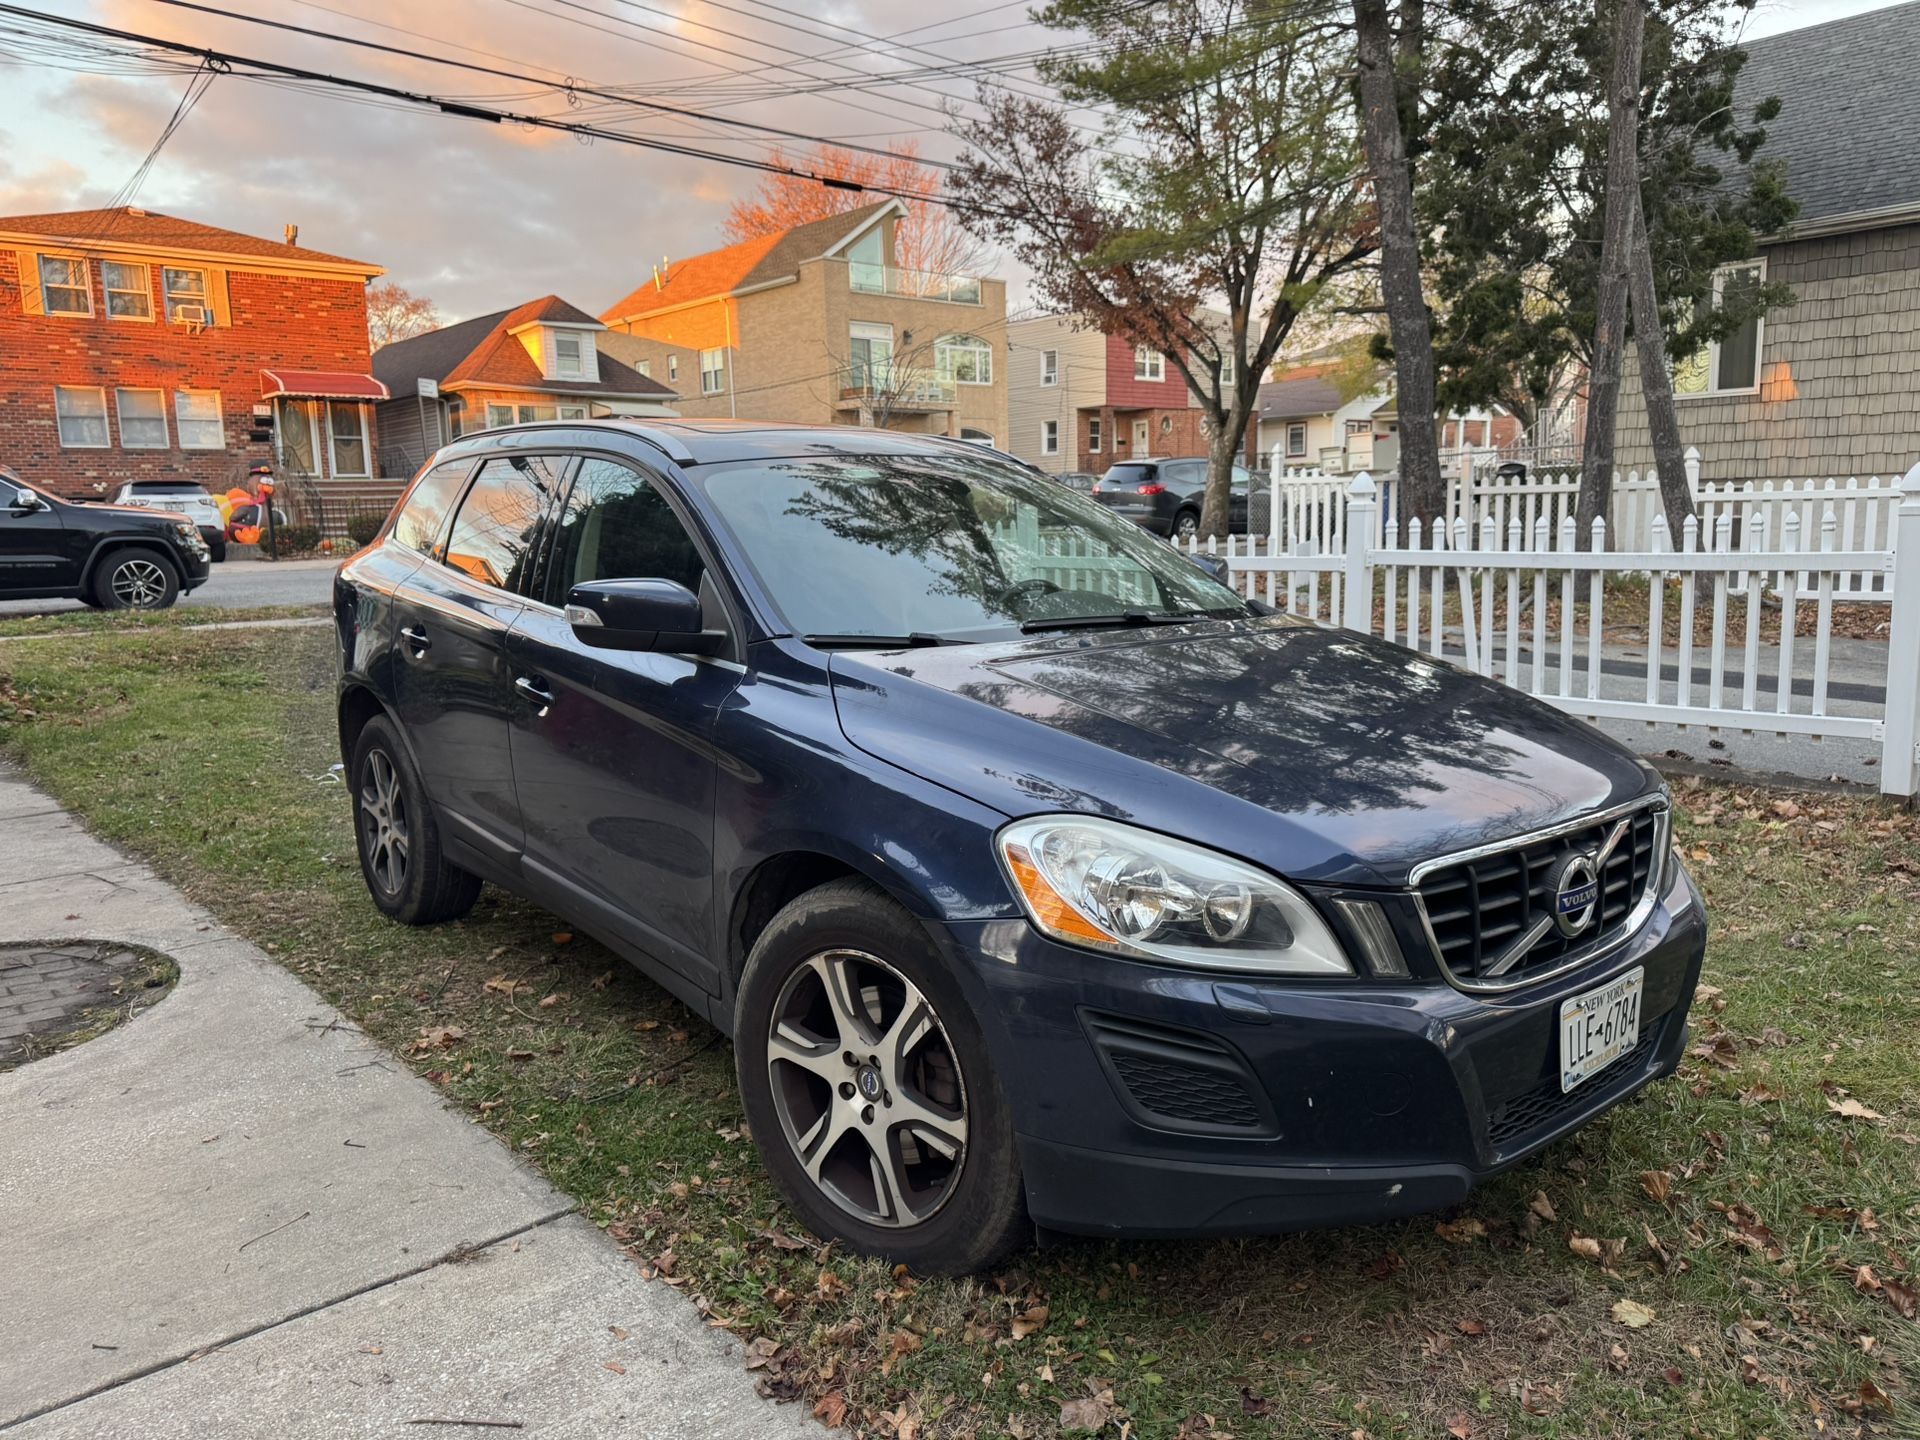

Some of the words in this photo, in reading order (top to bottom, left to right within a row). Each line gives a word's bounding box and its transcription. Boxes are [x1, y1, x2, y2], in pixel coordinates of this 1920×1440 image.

[1562, 887, 1597, 907] VOLVO
[1584, 993, 1605, 1013] NEW
[1606, 984, 1626, 1004] YORK
[1569, 1014, 1595, 1067] LLE
[1605, 992, 1637, 1046] 6784
